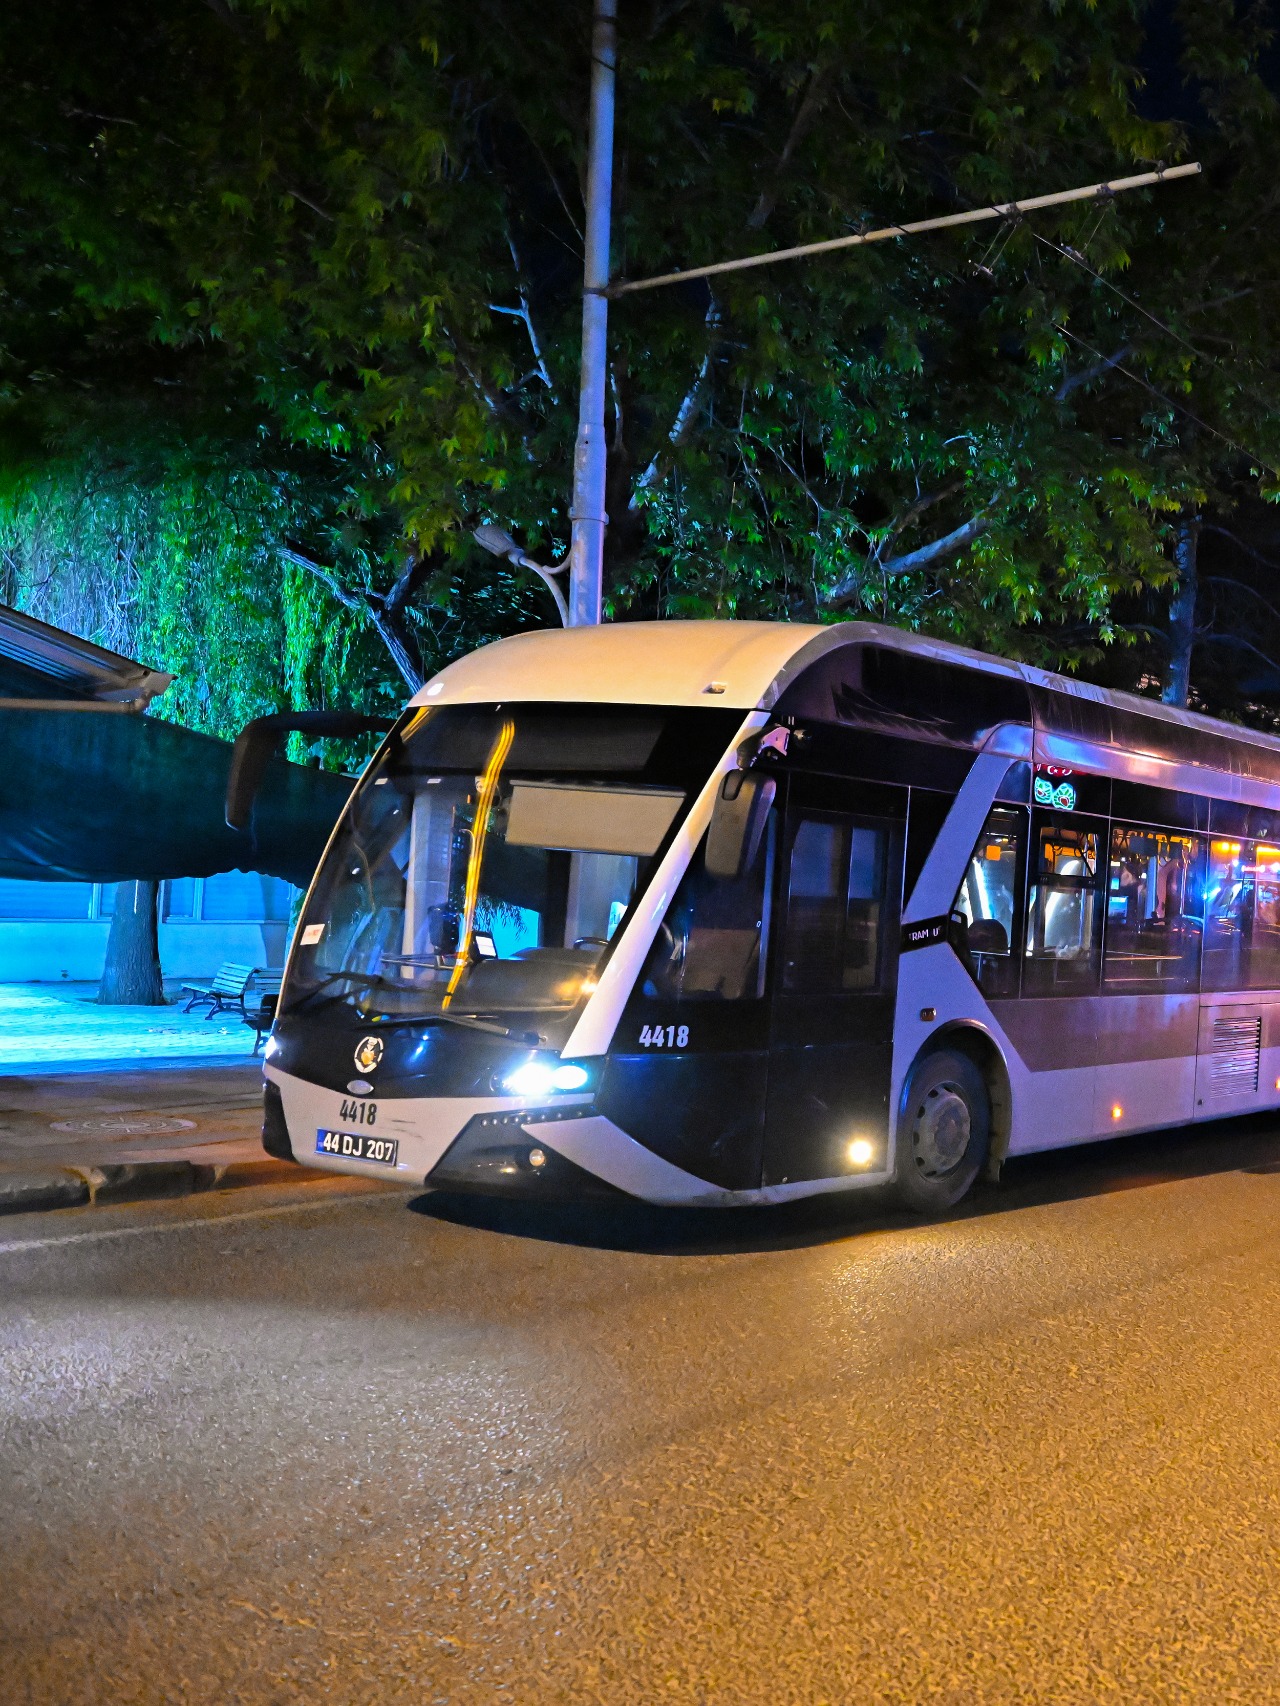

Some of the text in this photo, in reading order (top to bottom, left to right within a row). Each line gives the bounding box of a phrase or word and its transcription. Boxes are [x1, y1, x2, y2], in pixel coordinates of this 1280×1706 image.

[638, 1025, 690, 1048] 4418
[339, 1100, 378, 1126] 4418
[323, 1132, 394, 1161] 44 DJ 207
